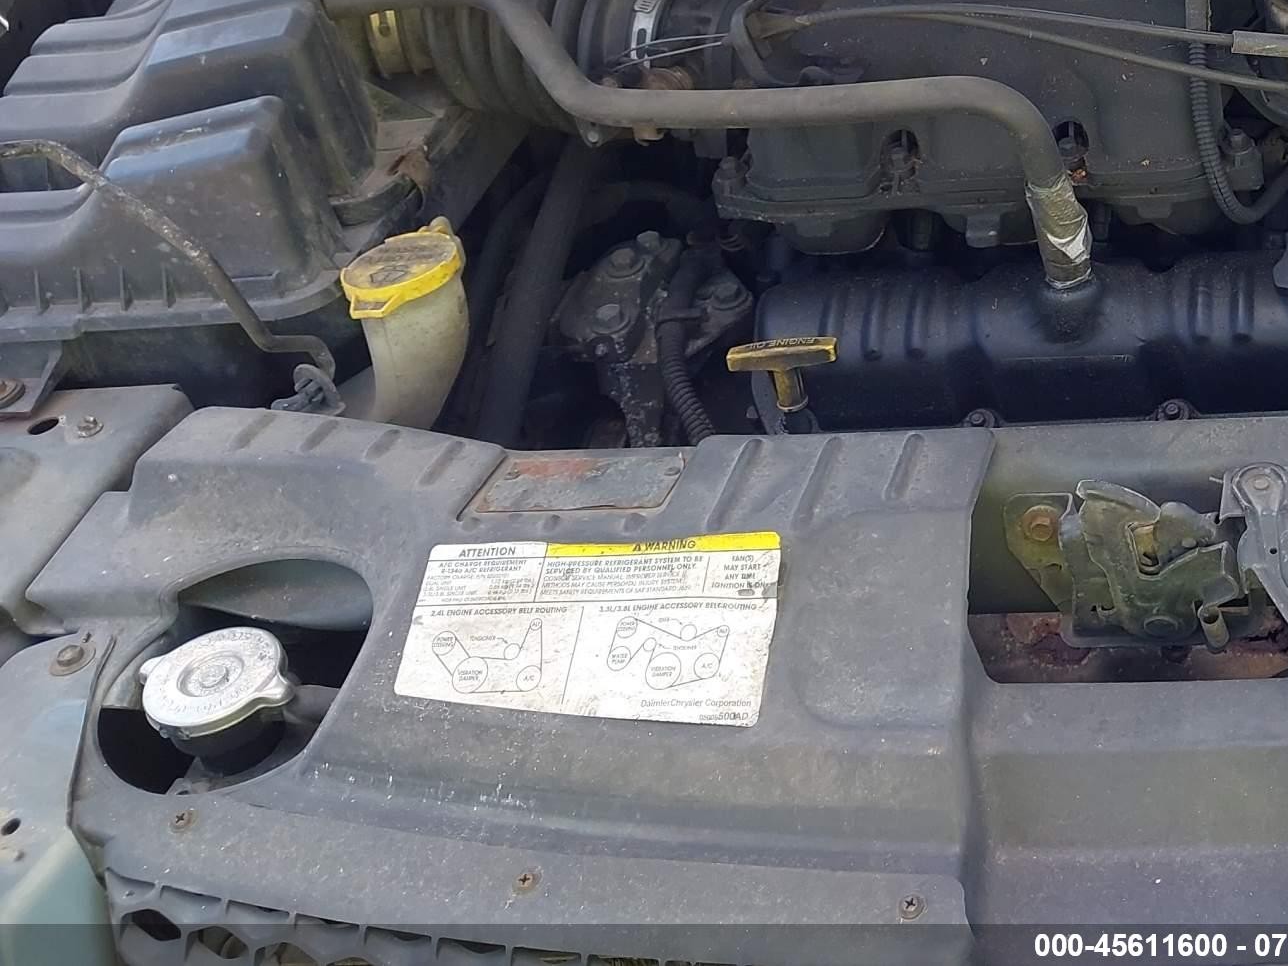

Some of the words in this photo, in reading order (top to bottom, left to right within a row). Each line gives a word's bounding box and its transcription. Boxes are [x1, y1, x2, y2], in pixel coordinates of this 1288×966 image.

[767, 336, 816, 347] ENGINE
[644, 539, 697, 551] WARNING
[458, 546, 516, 558] ATTENTION
[485, 559, 527, 567] REQUIREMENT
[547, 560, 602, 568] HIGH-PRESSURE
[605, 558, 652, 566] REFRIGERANT
[740, 563, 761, 571] START
[545, 567, 580, 575] SERVICED
[634, 564, 675, 572] PERSONNEL
[712, 581, 745, 589] IGNITION
[447, 609, 473, 617] ENGINE
[474, 608, 517, 616] ACCESSORY
[535, 606, 568, 614] ROUTING
[632, 604, 659, 612] ENGINE
[660, 602, 703, 610] ACCESSORY
[722, 603, 757, 611] ROUTING
[641, 699, 703, 708] DaimlerChrysler
[705, 699, 752, 708] Corporation
